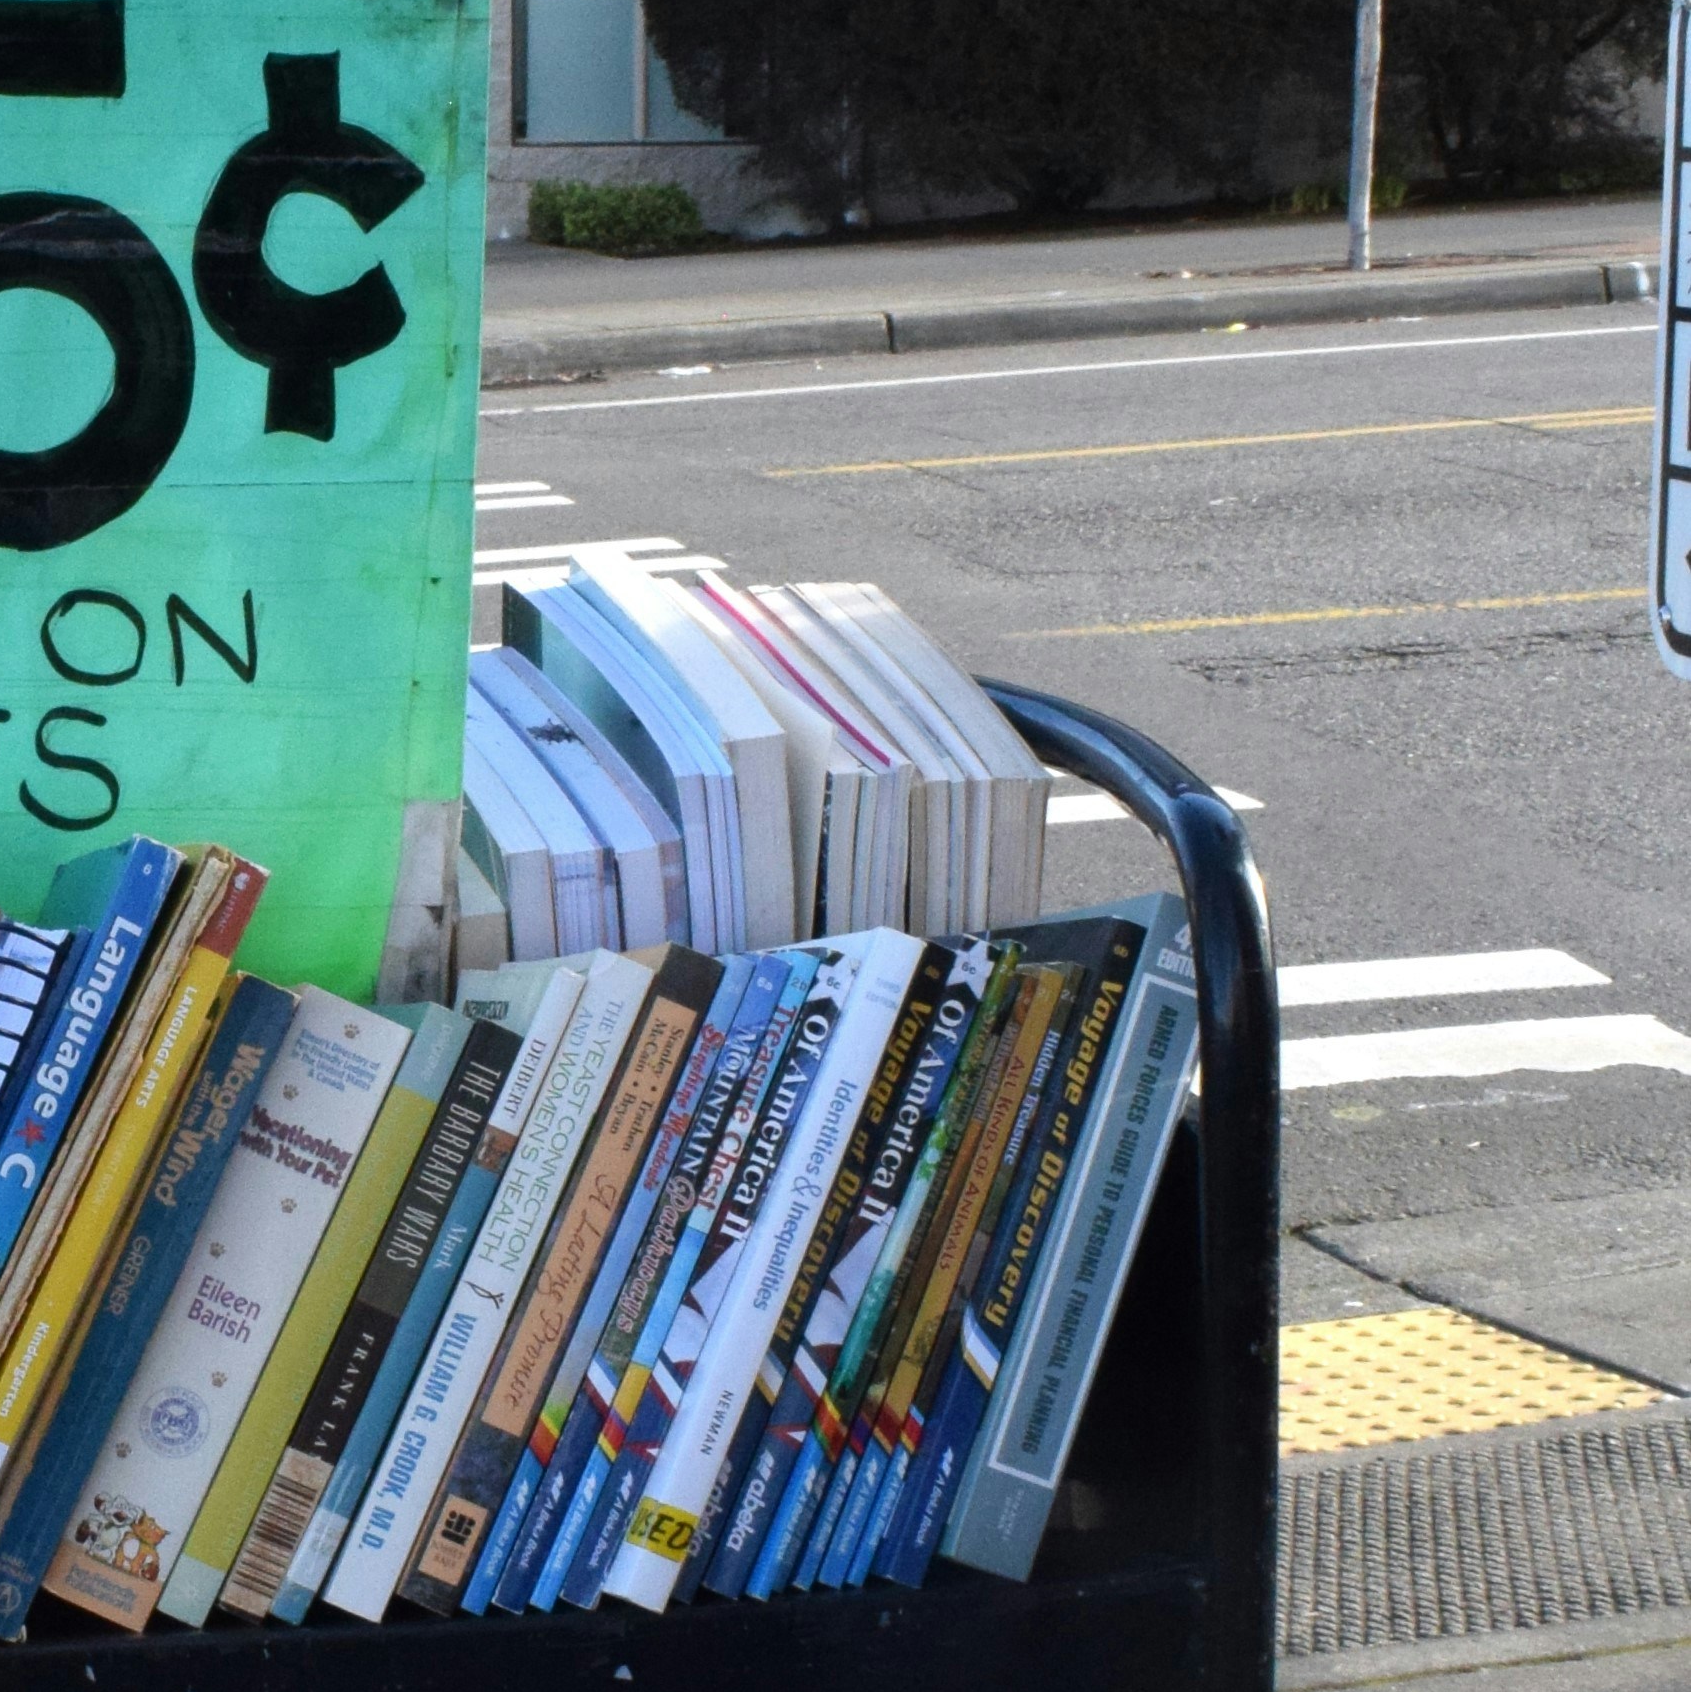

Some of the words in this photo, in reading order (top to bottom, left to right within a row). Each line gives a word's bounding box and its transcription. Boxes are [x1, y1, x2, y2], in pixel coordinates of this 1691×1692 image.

[41, 588, 255, 686] ON
[824, 974, 842, 990] 6c
[959, 960, 977, 975] 6c
[20, 910, 143, 1122] Language
[151, 983, 197, 1068] LANGUAGE
[565, 1006, 596, 1050] AND
[595, 997, 624, 1035] THE
[632, 1017, 668, 1075] McCain
[1055, 975, 1124, 1108] Voyage
[1146, 1003, 1178, 1060] ARMED
[134, 1068, 160, 1108] ARTS
[193, 1036, 266, 1145] Wager
[457, 1058, 502, 1103] THE
[499, 1036, 548, 1119] DEIBERT
[563, 1033, 612, 1114] YEAST
[668, 1020, 727, 1113] Sunshine
[728, 999, 799, 1126] Treasure
[1029, 1030, 1062, 1090] Hidden
[1125, 1062, 1160, 1125] FORCES
[518, 1047, 580, 1163] WOMEN'S
[604, 1089, 637, 1137] Bryan
[803, 1078, 858, 1177] Identities
[1002, 1091, 1041, 1166] Treasure
[1048, 1111, 1074, 1145] of
[148, 1125, 205, 1208] Wind
[412, 1102, 482, 1205] BARBARY
[638, 1106, 691, 1195] Meadows
[693, 1128, 746, 1214] Chest
[790, 1173, 824, 1202] &
[1108, 1126, 1139, 1178] GUIDE
[475, 1166, 531, 1264] HEALTH
[497, 1112, 579, 1273] CONNECTION
[1100, 1179, 1123, 1203] TO
[102, 1232, 154, 1316] GREINER
[384, 1203, 437, 1269] WARS
[430, 1219, 469, 1275] Mark
[745, 1198, 810, 1312] Inequalities
[979, 1147, 1066, 1331] Discovery
[1074, 1205, 1115, 1286] PERSONAL
[187, 1297, 252, 1344] Barish
[196, 1274, 261, 1321] Eileen
[1046, 1288, 1089, 1372] FINANCIAL
[697, 1389, 735, 1456] NEWMAN
[1019, 1373, 1062, 1456] PLANNING
[529, 1509, 551, 1539] Beka
[540, 1496, 556, 1512] A
[725, 1477, 773, 1554] abeka
[517, 1537, 540, 1571] Book
